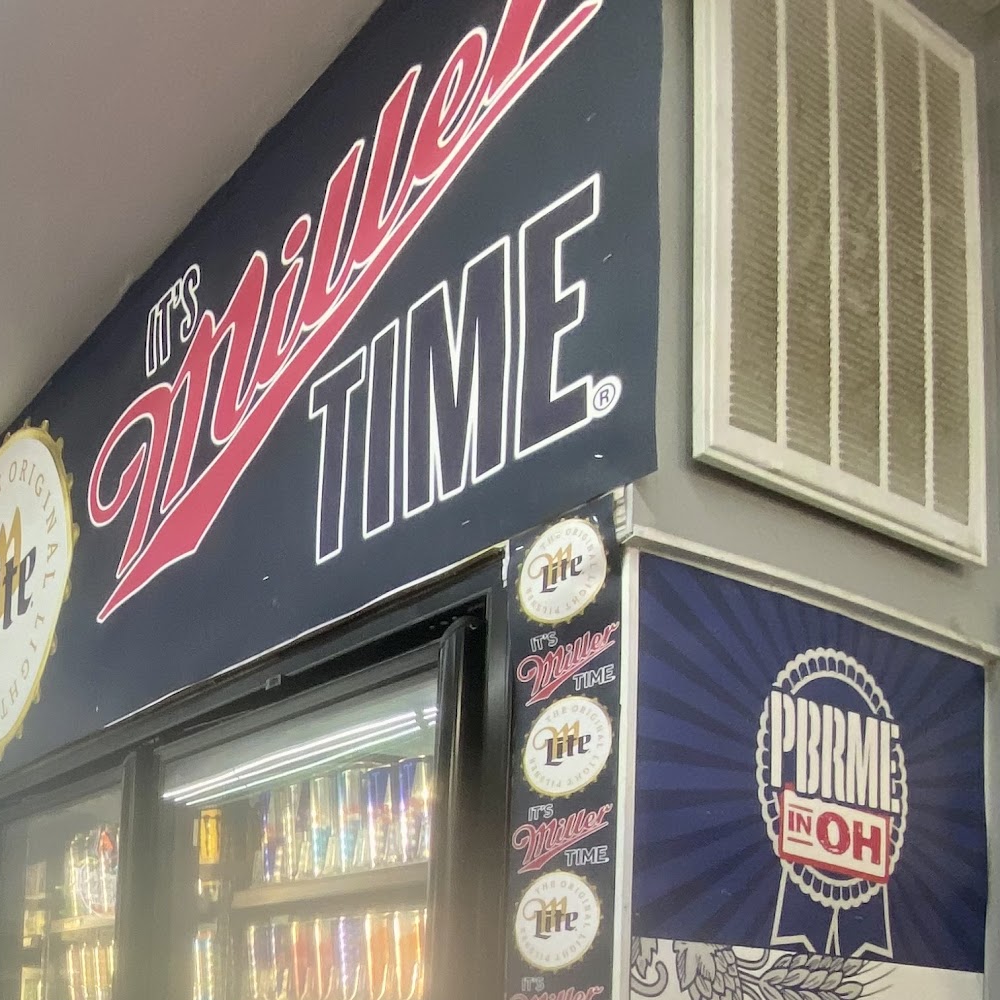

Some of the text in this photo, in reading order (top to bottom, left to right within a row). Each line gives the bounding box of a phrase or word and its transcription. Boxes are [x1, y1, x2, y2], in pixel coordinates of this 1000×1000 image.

[88, 0, 601, 622] Miller
[145, 263, 201, 377] IT'S
[309, 173, 601, 565] TIME
[8, 459, 58, 589] ORIGINAL
[540, 554, 583, 593] Lite
[1, 612, 45, 720] LIGHT
[516, 621, 620, 706] Miller
[530, 631, 558, 652] IT'S
[573, 663, 616, 691] TIME
[545, 733, 591, 766] Lite
[769, 690, 900, 813] PBRME
[512, 803, 613, 874] Miller
[528, 803, 554, 822] IT'S
[787, 809, 880, 866] IN OH
[564, 845, 610, 867] TIME
[533, 910, 579, 940] Lite
[521, 976, 545, 992] IT'S
